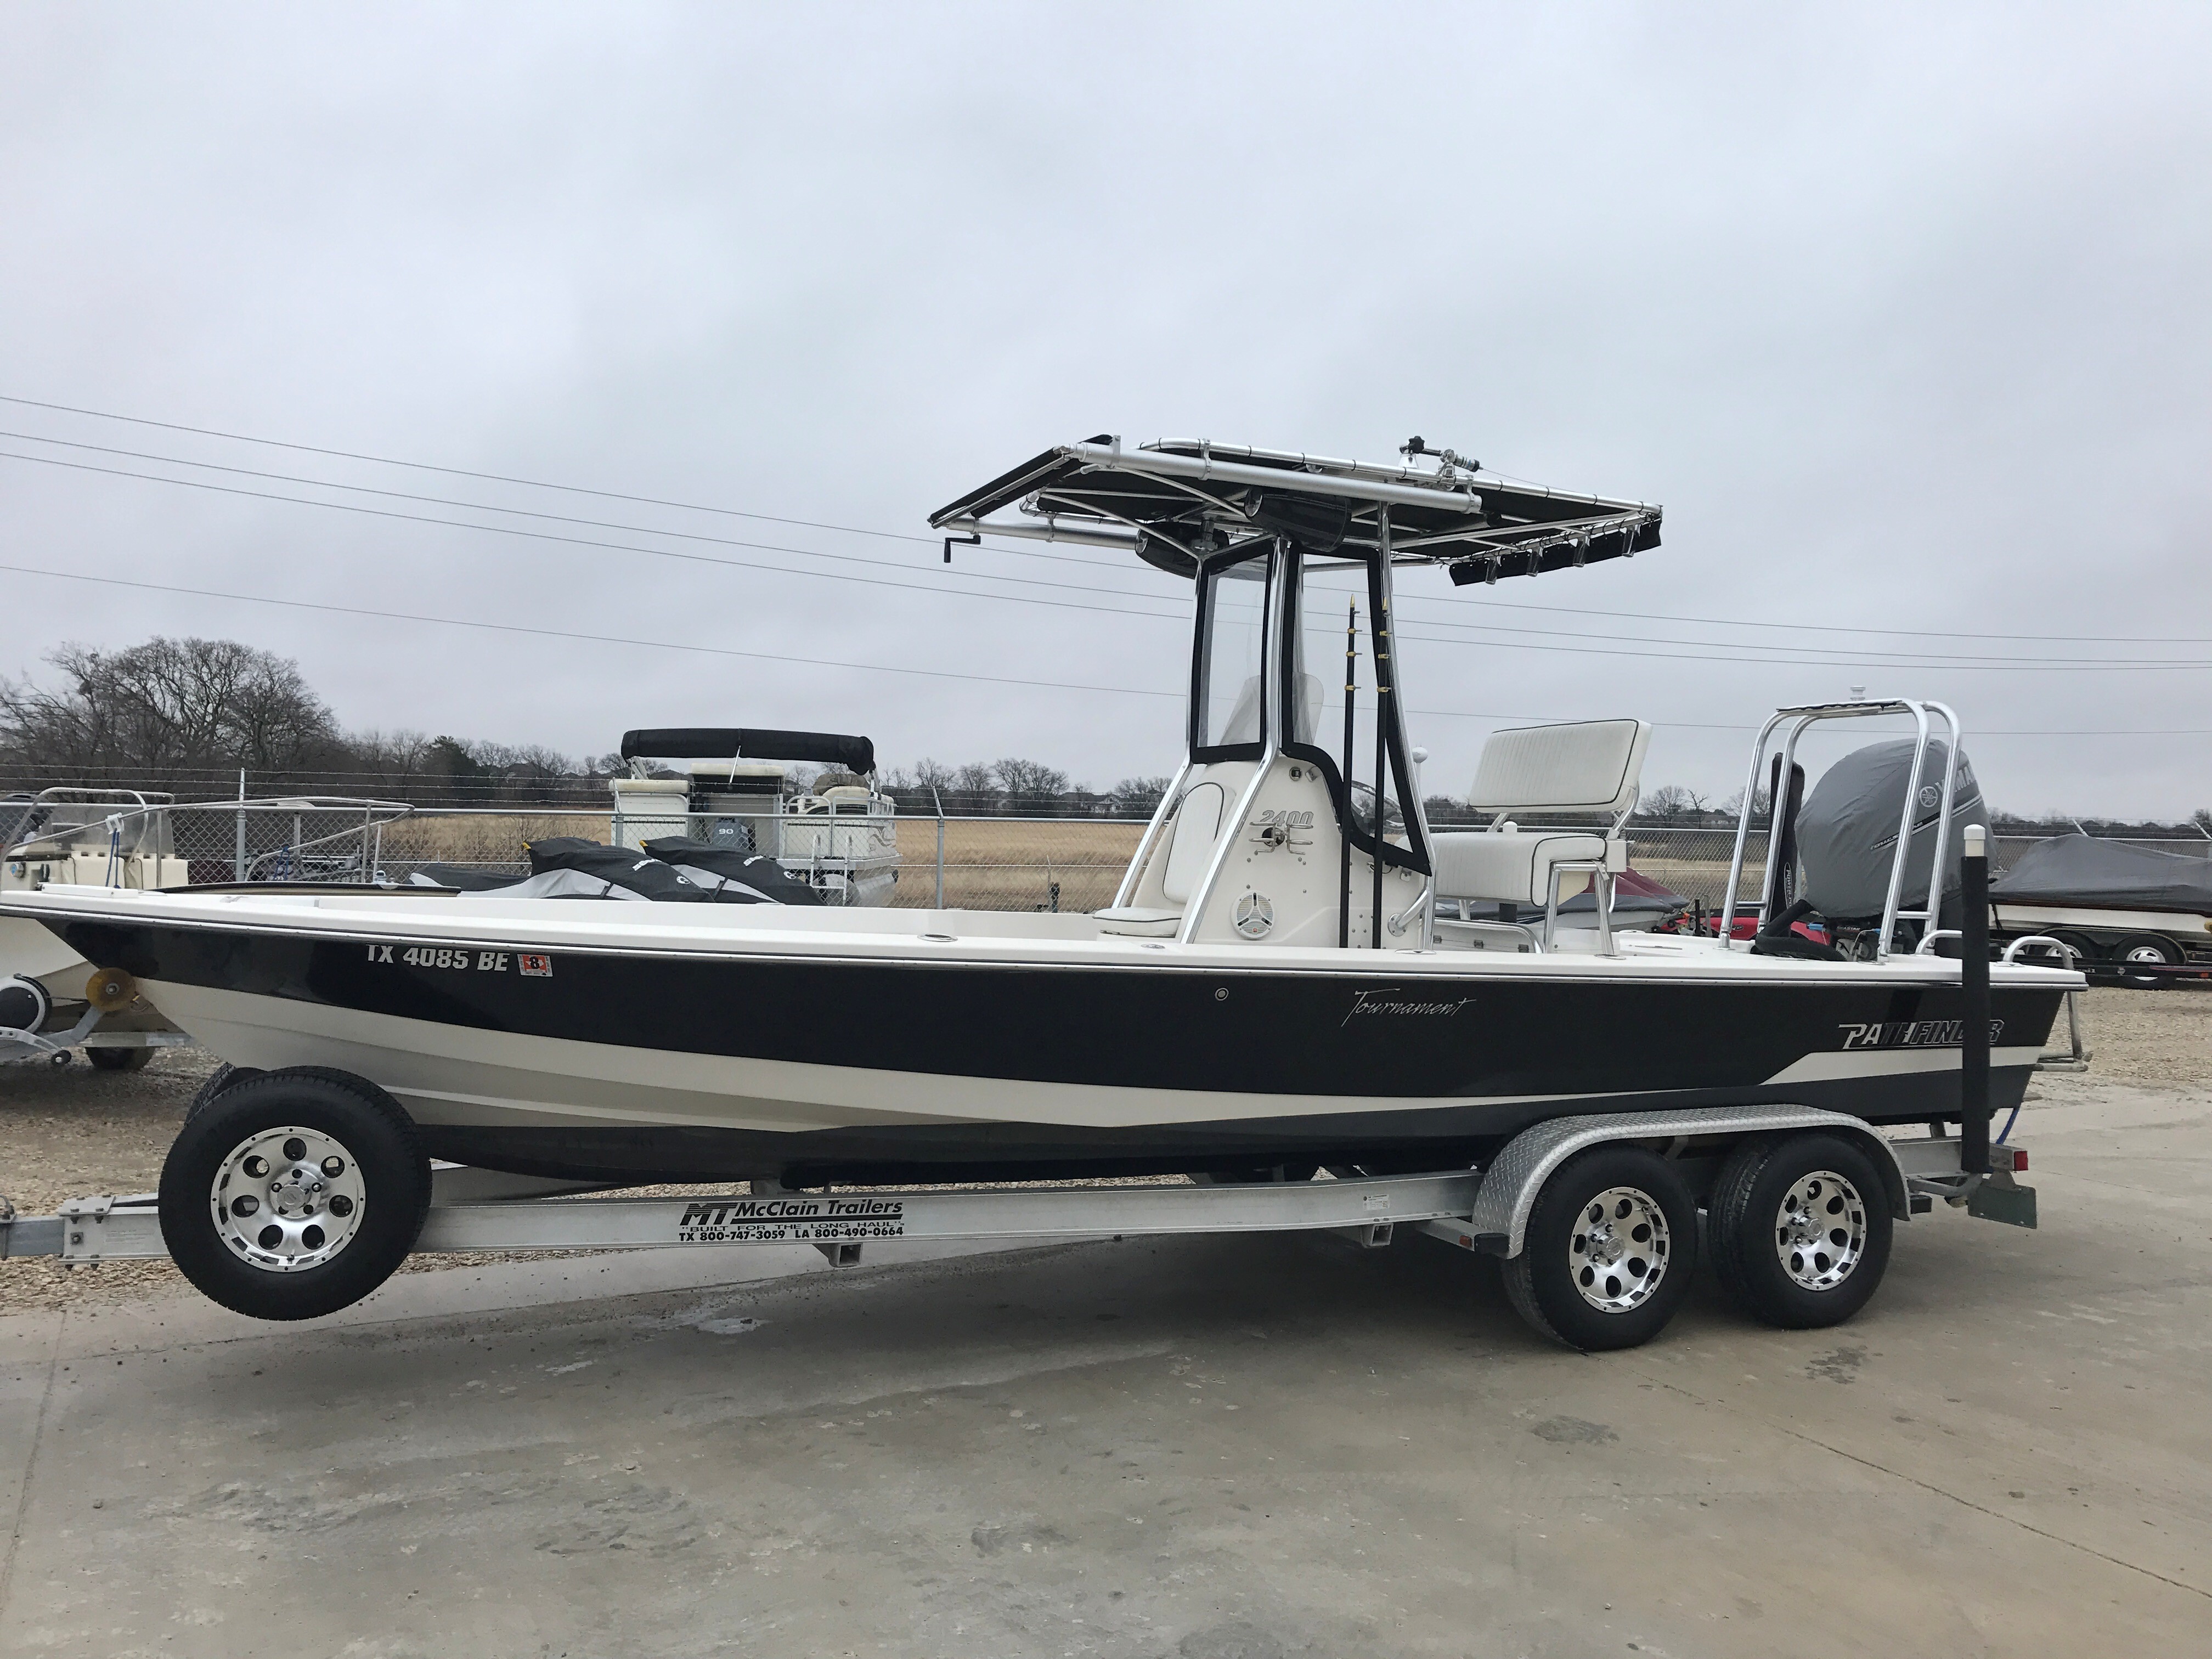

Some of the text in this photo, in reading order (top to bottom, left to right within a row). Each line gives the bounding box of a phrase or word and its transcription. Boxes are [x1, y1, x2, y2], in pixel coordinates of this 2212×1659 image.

[1260, 810, 1314, 827] 2400
[365, 944, 510, 972] TX 4085 BE
[529, 956, 540, 969] 8
[1341, 988, 1476, 1027] Tournament
[680, 1203, 738, 1226] MT
[735, 1199, 903, 1217] McClain Trailers
[679, 1226, 904, 1242] TX 800-747-3059 LA 800-490-0664
